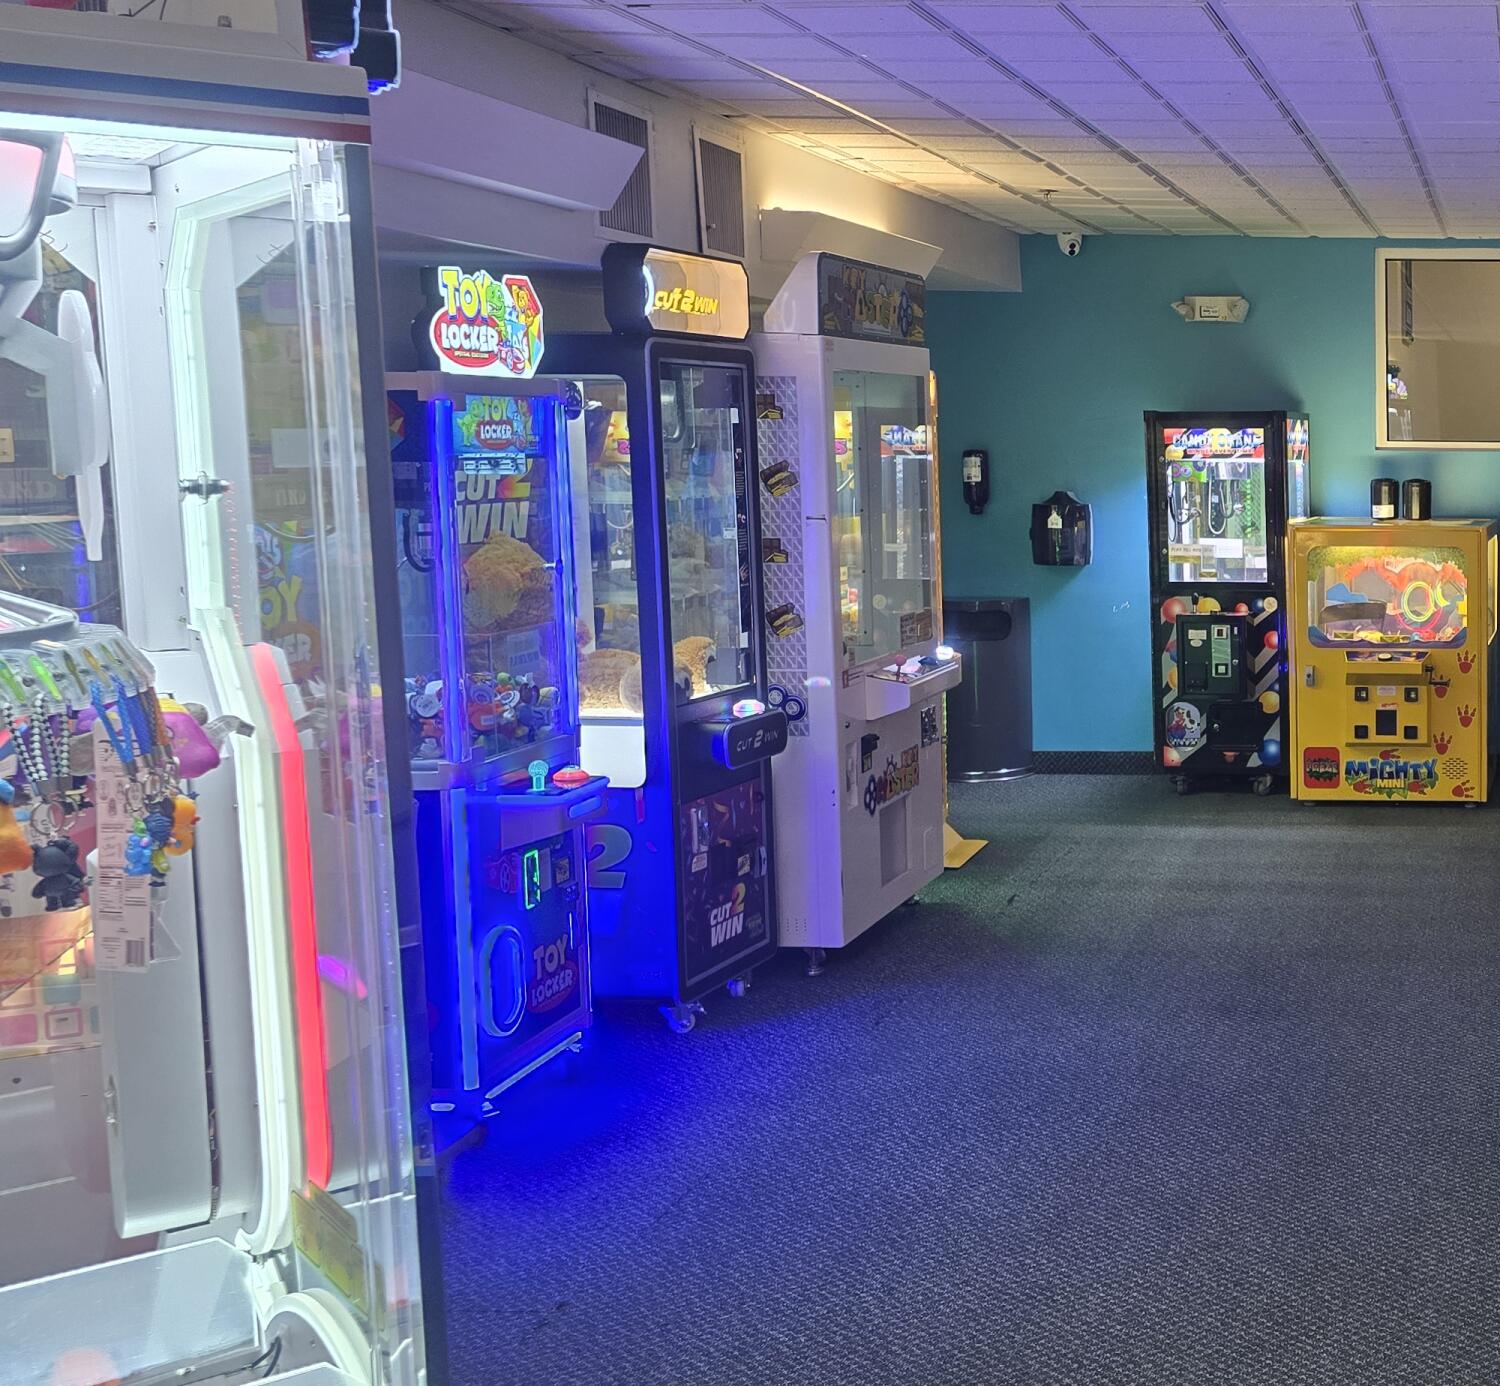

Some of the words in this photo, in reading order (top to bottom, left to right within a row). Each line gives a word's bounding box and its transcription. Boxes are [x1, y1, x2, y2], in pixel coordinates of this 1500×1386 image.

[441, 269, 493, 321] TOY
[440, 322, 499, 352] LOCKER
[482, 396, 509, 421] TOY
[480, 424, 512, 440] LOCKER
[455, 471, 500, 500] CUT
[457, 501, 530, 544] WIN
[258, 575, 302, 631] OY
[737, 738, 752, 752] CUT
[754, 729, 763, 748] 2
[1376, 779, 1405, 788] MINI
[711, 901, 732, 926] CUT
[731, 882, 746, 914] 2
[711, 912, 744, 948] WIN
[533, 934, 568, 970] TOY
[531, 968, 574, 1007] LOCKER
